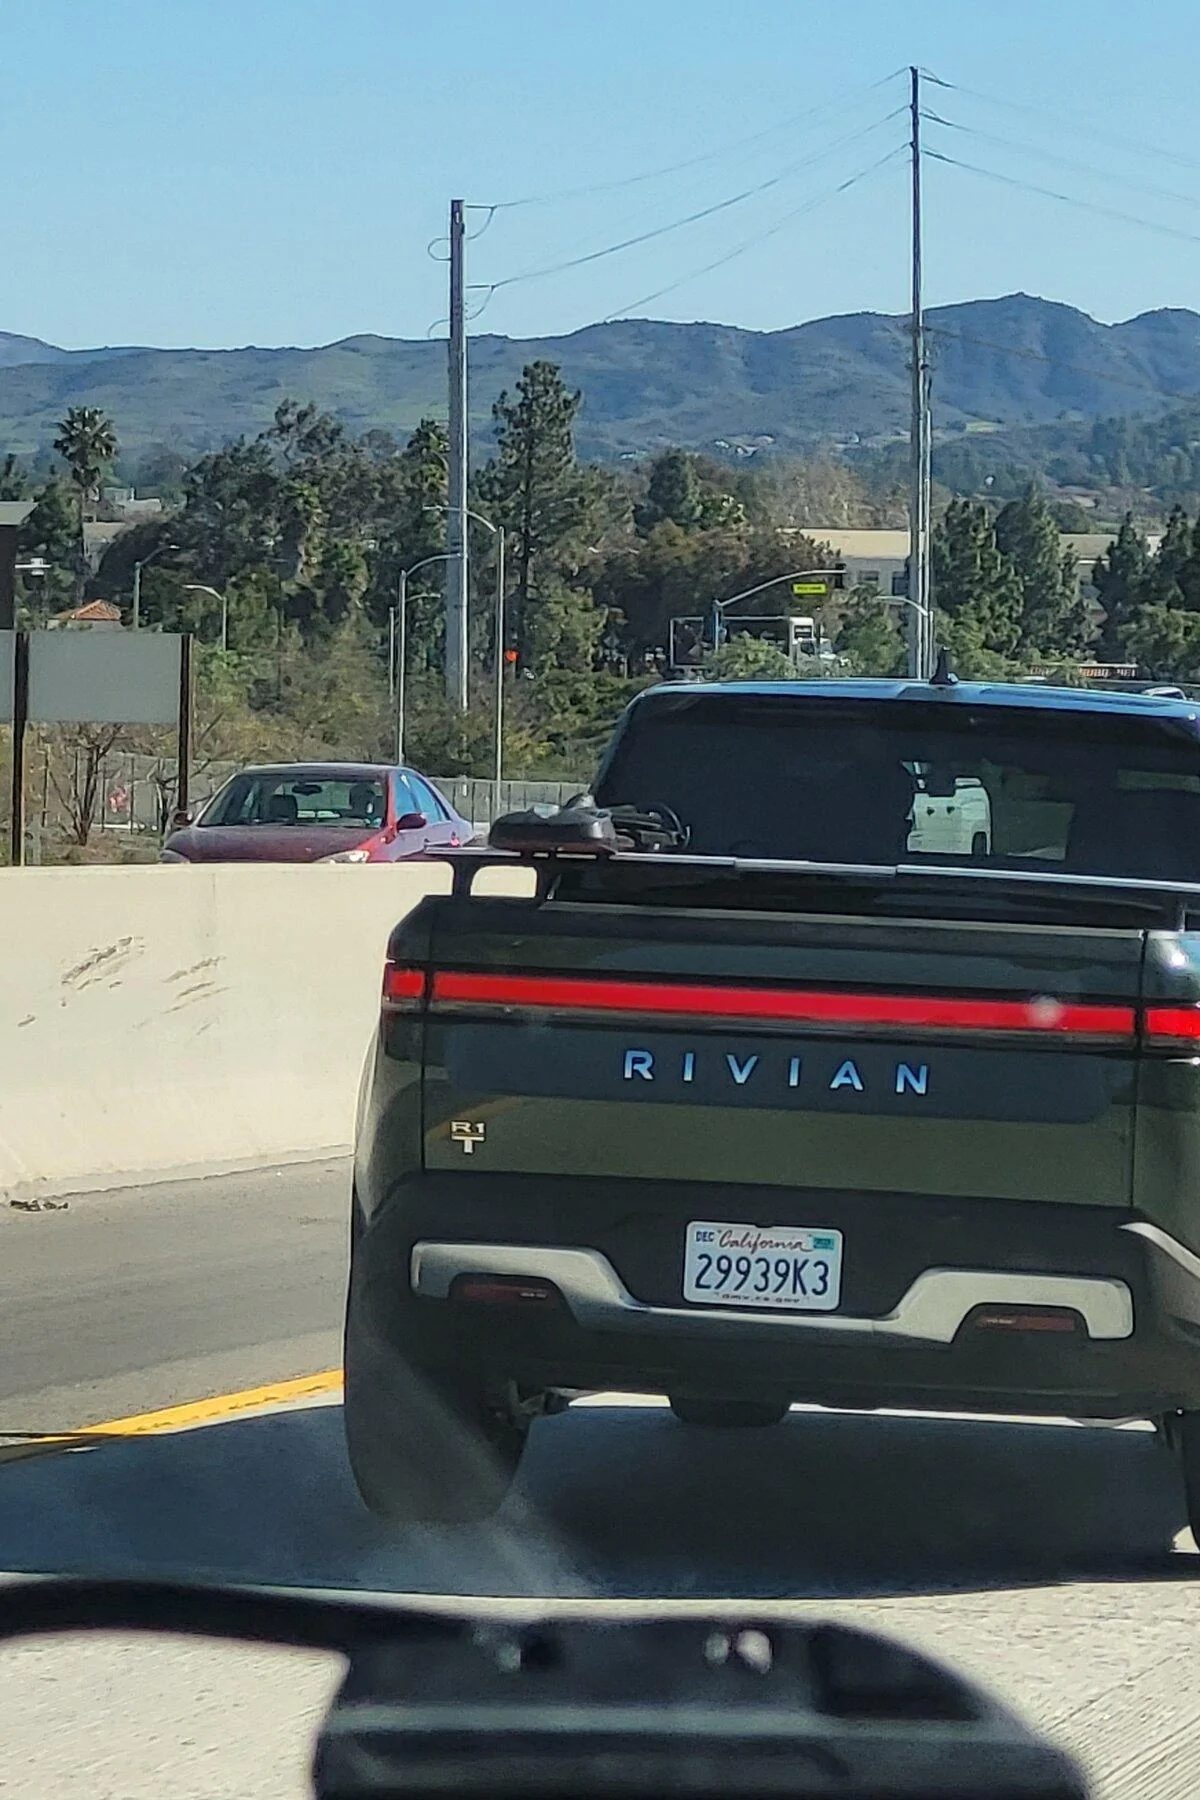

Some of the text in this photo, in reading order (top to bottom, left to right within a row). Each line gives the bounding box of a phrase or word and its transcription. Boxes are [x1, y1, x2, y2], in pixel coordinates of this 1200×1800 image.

[623, 1050, 929, 1094] RIVIAN
[695, 1231, 714, 1242] DEC
[719, 1229, 812, 1254] California
[695, 1253, 829, 1296] 29939K3
